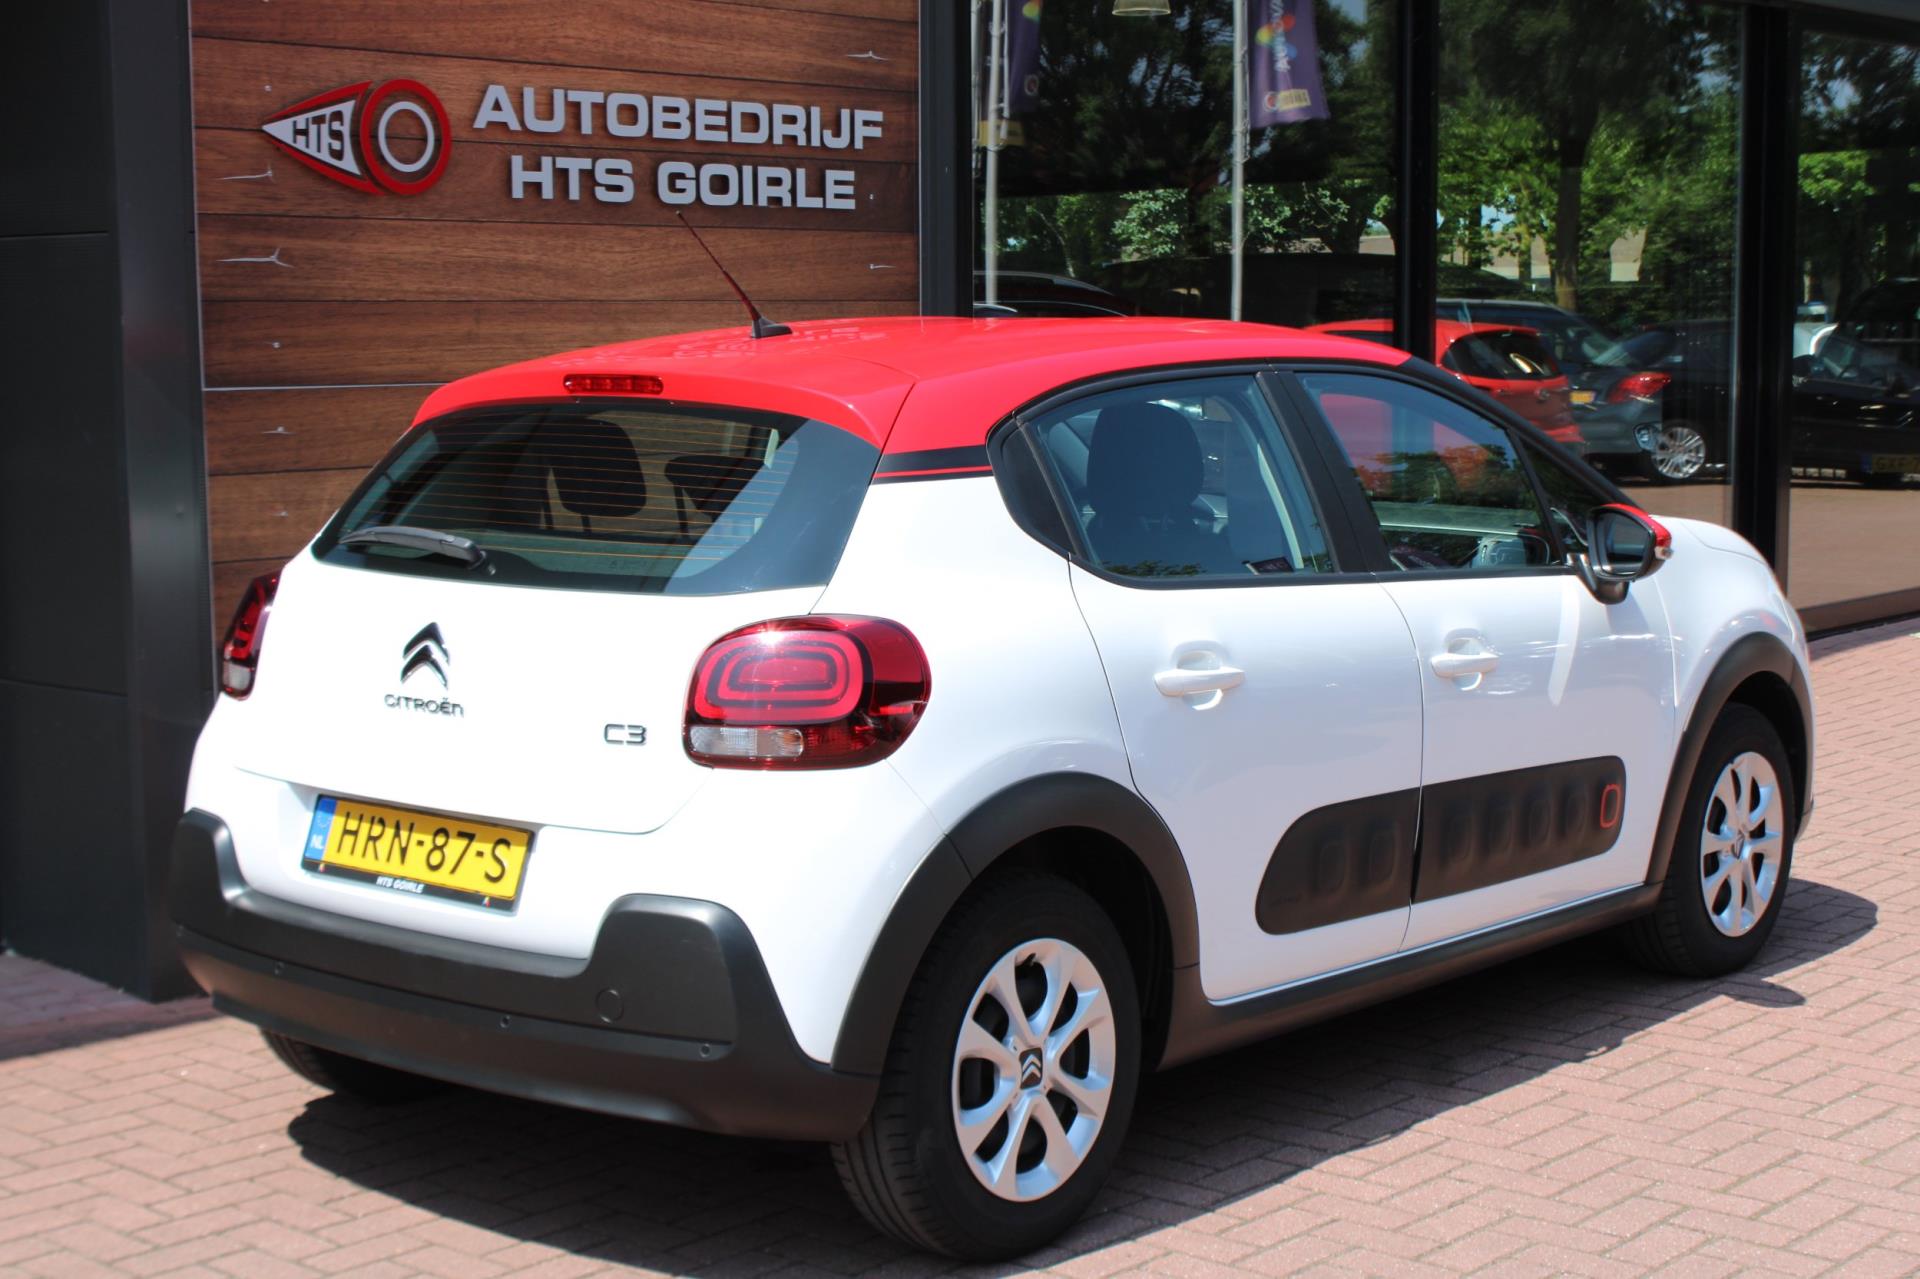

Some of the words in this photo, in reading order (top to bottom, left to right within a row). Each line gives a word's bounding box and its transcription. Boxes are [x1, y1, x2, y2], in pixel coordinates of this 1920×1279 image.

[292, 110, 344, 162] HTS
[473, 84, 884, 150] AUTOBEDRIJF
[510, 154, 635, 203] HTS
[656, 161, 856, 210] GOIRLE
[604, 723, 647, 745] C3
[310, 834, 325, 850] NL
[336, 811, 511, 883] HRN-87-S
